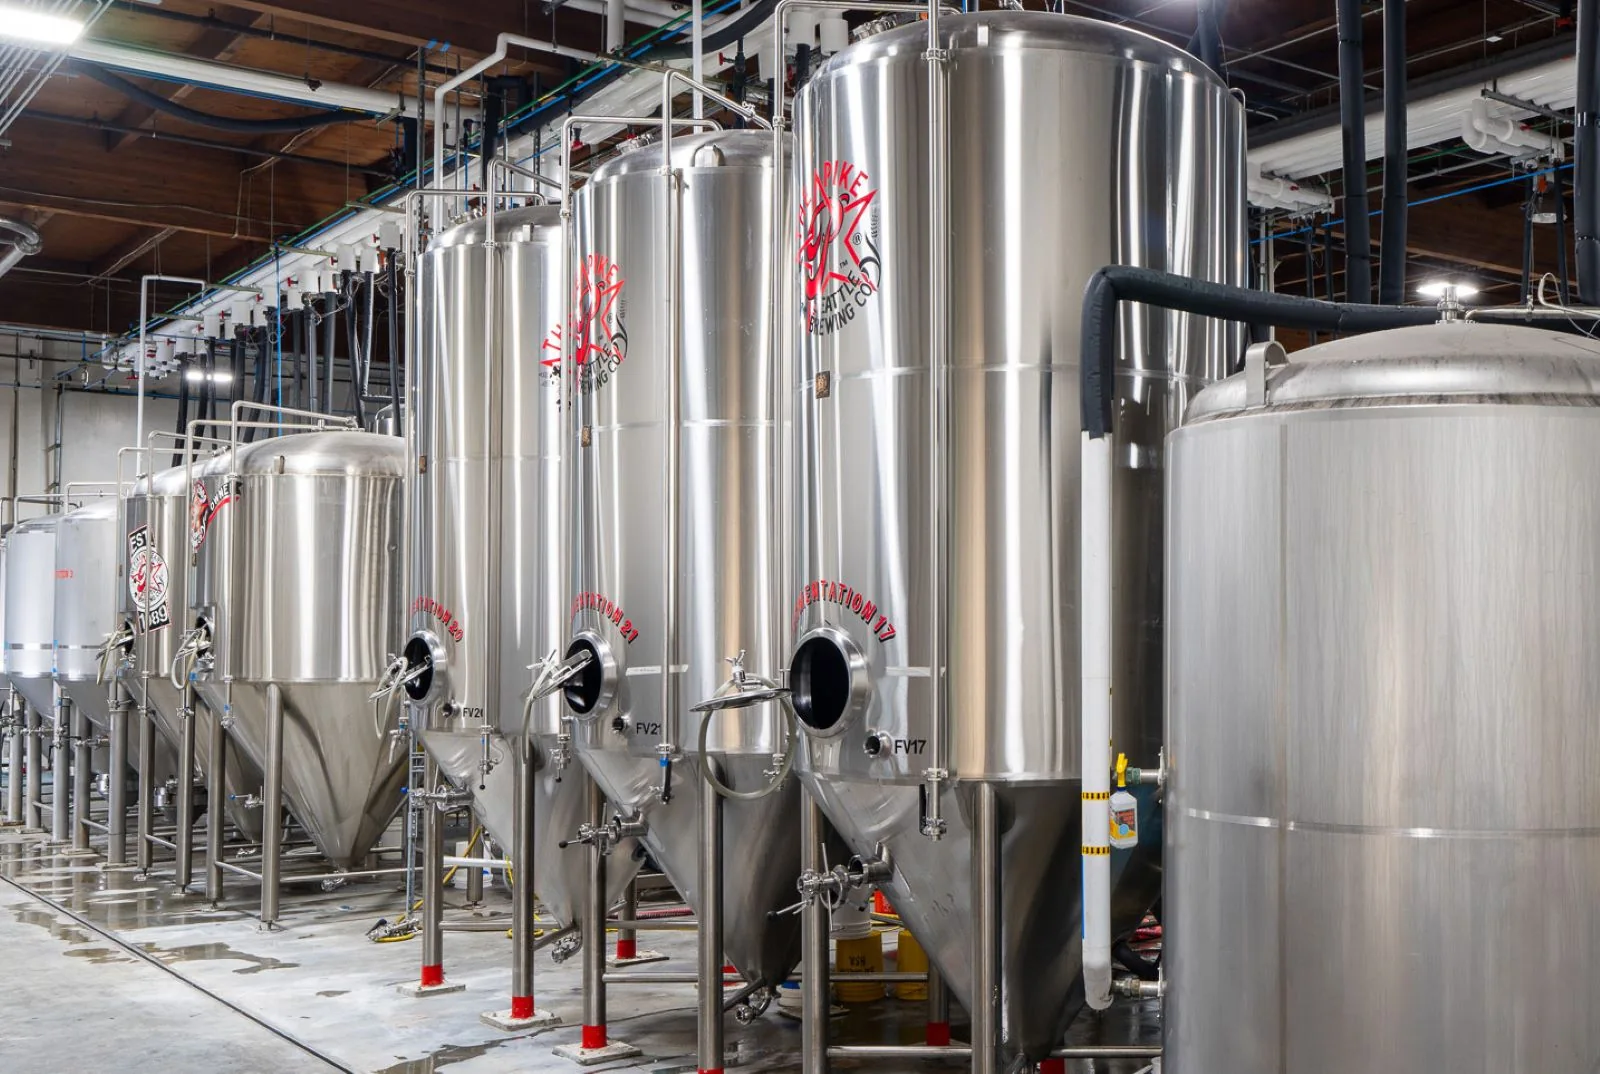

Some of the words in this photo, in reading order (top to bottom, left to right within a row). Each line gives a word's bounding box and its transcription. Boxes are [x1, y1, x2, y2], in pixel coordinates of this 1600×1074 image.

[823, 160, 868, 197] PIKE
[817, 270, 860, 315] EATTLE
[138, 604, 168, 632] 189
[448, 620, 464, 643] 20
[620, 619, 639, 644] 21
[874, 615, 897, 642] 17
[894, 739, 927, 755] FV17
